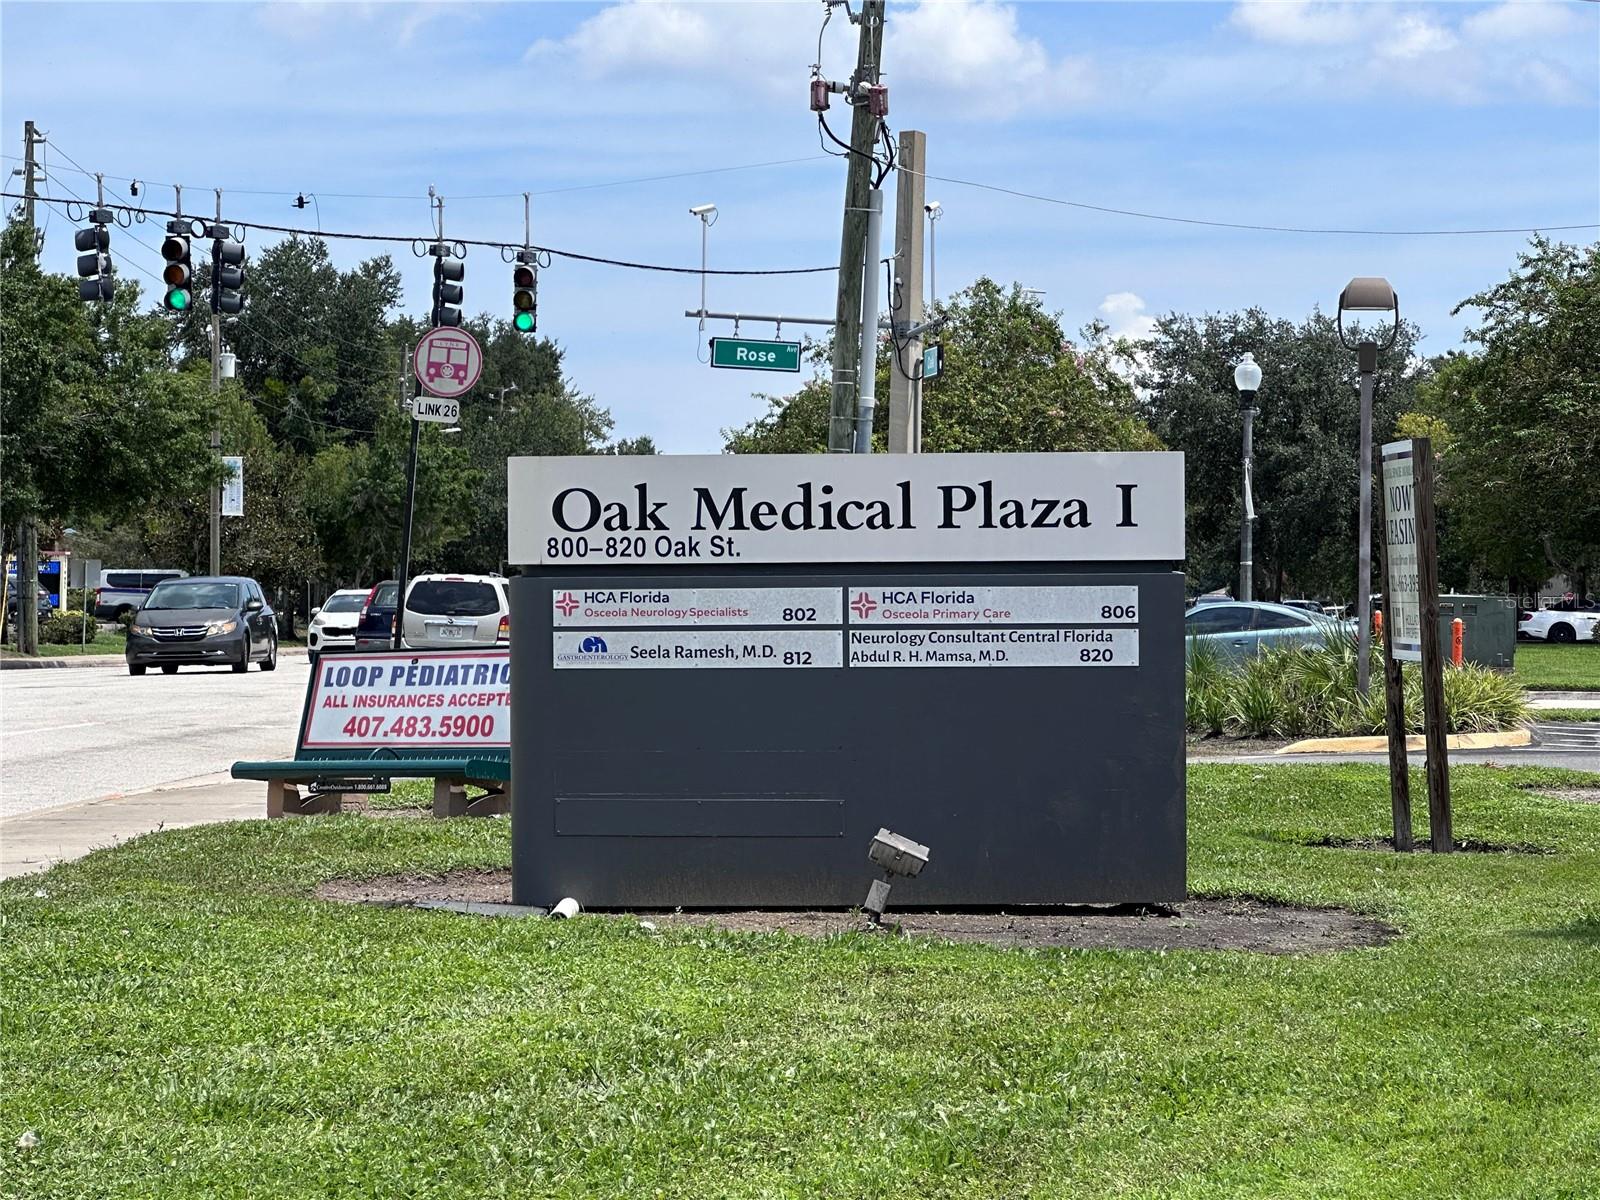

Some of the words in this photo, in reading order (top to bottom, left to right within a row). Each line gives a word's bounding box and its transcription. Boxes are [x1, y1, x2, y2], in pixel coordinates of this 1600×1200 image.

[736, 347, 776, 362] Rose
[786, 345, 798, 353] Ave
[417, 402, 442, 416] LINK
[443, 405, 458, 417] 26
[1389, 484, 1412, 512] NOW
[551, 482, 670, 532] Oak
[690, 480, 917, 532] Medical
[937, 480, 1092, 530] Plaza
[1115, 484, 1138, 527] I
[654, 535, 700, 558] Oak
[710, 535, 741, 558] St.
[584, 591, 616, 604] HCA
[620, 591, 670, 604] Florida
[882, 591, 917, 604] HCA
[921, 591, 975, 604] Florida
[584, 607, 627, 617] Osceola
[631, 607, 688, 619] Neurology
[689, 607, 749, 619] Specialists
[782, 607, 817, 621] 802
[882, 608, 929, 619] Osceola
[933, 608, 979, 620] Primary
[983, 608, 1011, 619] Care
[1101, 605, 1136, 619] 806
[851, 631, 926, 647] Neurology
[928, 630, 1006, 644] Consultant
[1009, 630, 1060, 643] Central
[1063, 630, 1114, 643] Florida
[630, 645, 670, 659] Seela
[674, 644, 739, 660] Ramesh,
[742, 645, 777, 658] M.D.
[783, 651, 813, 665] 812
[850, 650, 890, 662] Abdul
[893, 650, 906, 662] R.
[909, 650, 923, 662] H.
[926, 650, 976, 663] Mamsa,
[978, 650, 1009, 662] M.D.
[1080, 648, 1114, 662] 820
[323, 665, 384, 688] LOOP
[322, 695, 349, 709] ALL
[352, 693, 445, 708] INSURANCES
[342, 714, 495, 738] 407.483.5900
